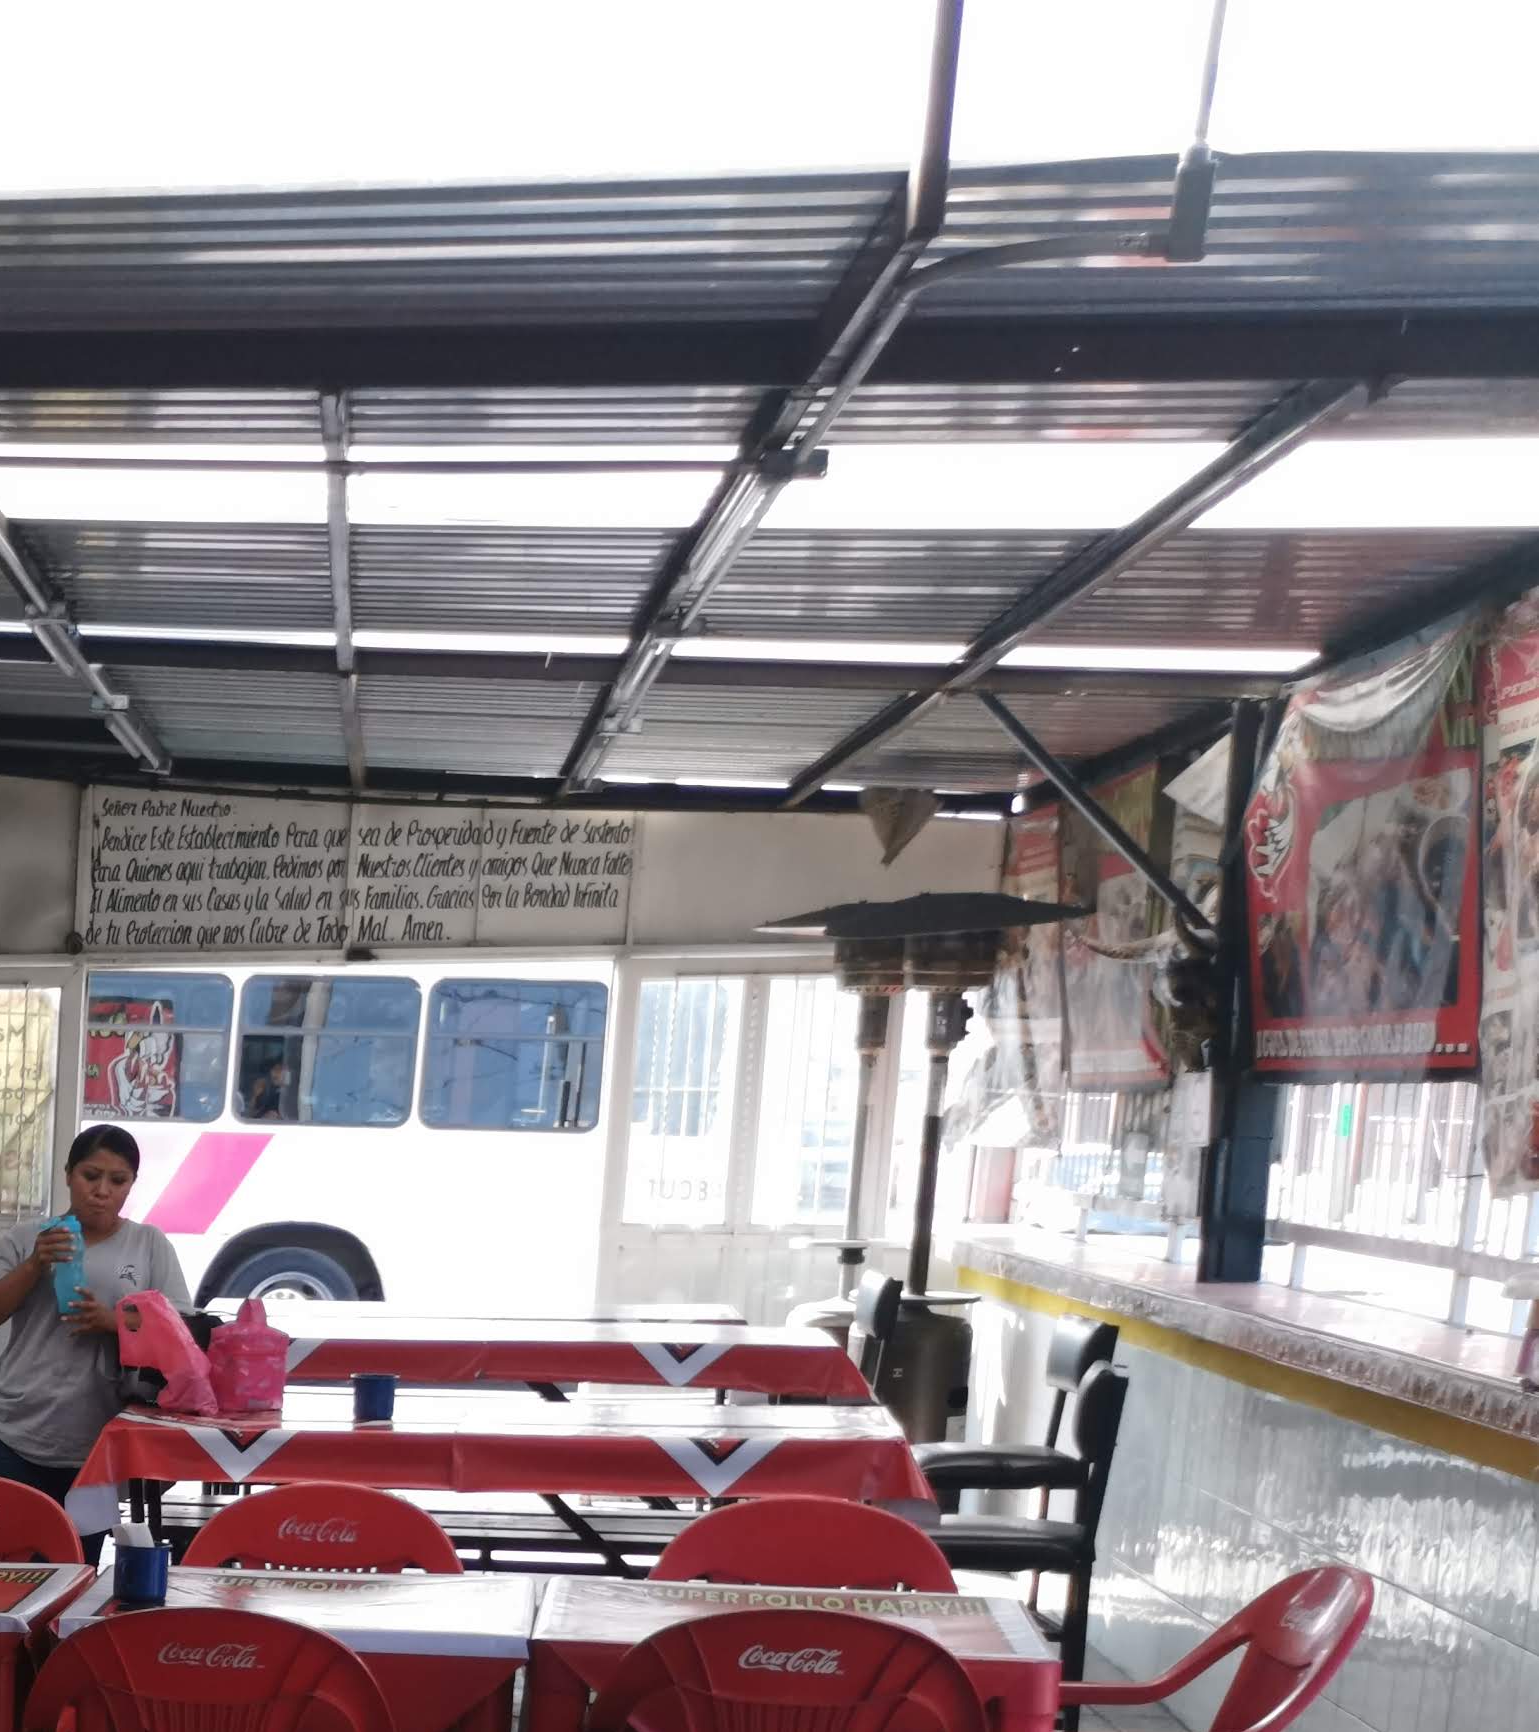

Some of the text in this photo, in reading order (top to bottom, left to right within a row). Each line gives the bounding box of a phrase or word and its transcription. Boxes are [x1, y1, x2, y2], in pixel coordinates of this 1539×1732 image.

[102, 798, 137, 817] Señor
[142, 798, 176, 817] Padre
[102, 819, 580, 852] Bendice Este Establecimiento Para que sea de Prosperidad Fuente de
[127, 857, 172, 883] Quienes
[273, 854, 323, 881] Pedimos
[357, 852, 411, 879] Nuestros
[413, 852, 464, 879] Clientes
[482, 852, 527, 882] amigos
[531, 852, 556, 879] Que
[105, 888, 160, 913] Alimento
[163, 892, 179, 913] en
[182, 891, 203, 914] sus
[207, 886, 241, 913] Casas
[274, 885, 312, 913] Salud
[315, 889, 332, 912] en
[426, 883, 474, 910] Gracias
[505, 883, 519, 908] la
[523, 881, 570, 908] Bondad
[106, 920, 121, 945] tu
[197, 924, 220, 949] que
[223, 924, 245, 945] nos
[250, 918, 288, 945] Cubre
[293, 916, 312, 945] de
[277, 1516, 360, 1544] Coca-Cola
[746, 1590, 846, 1613] POLLO
[157, 1642, 265, 1671] Coca-Cola
[738, 1643, 845, 1676] Coca-Cola
